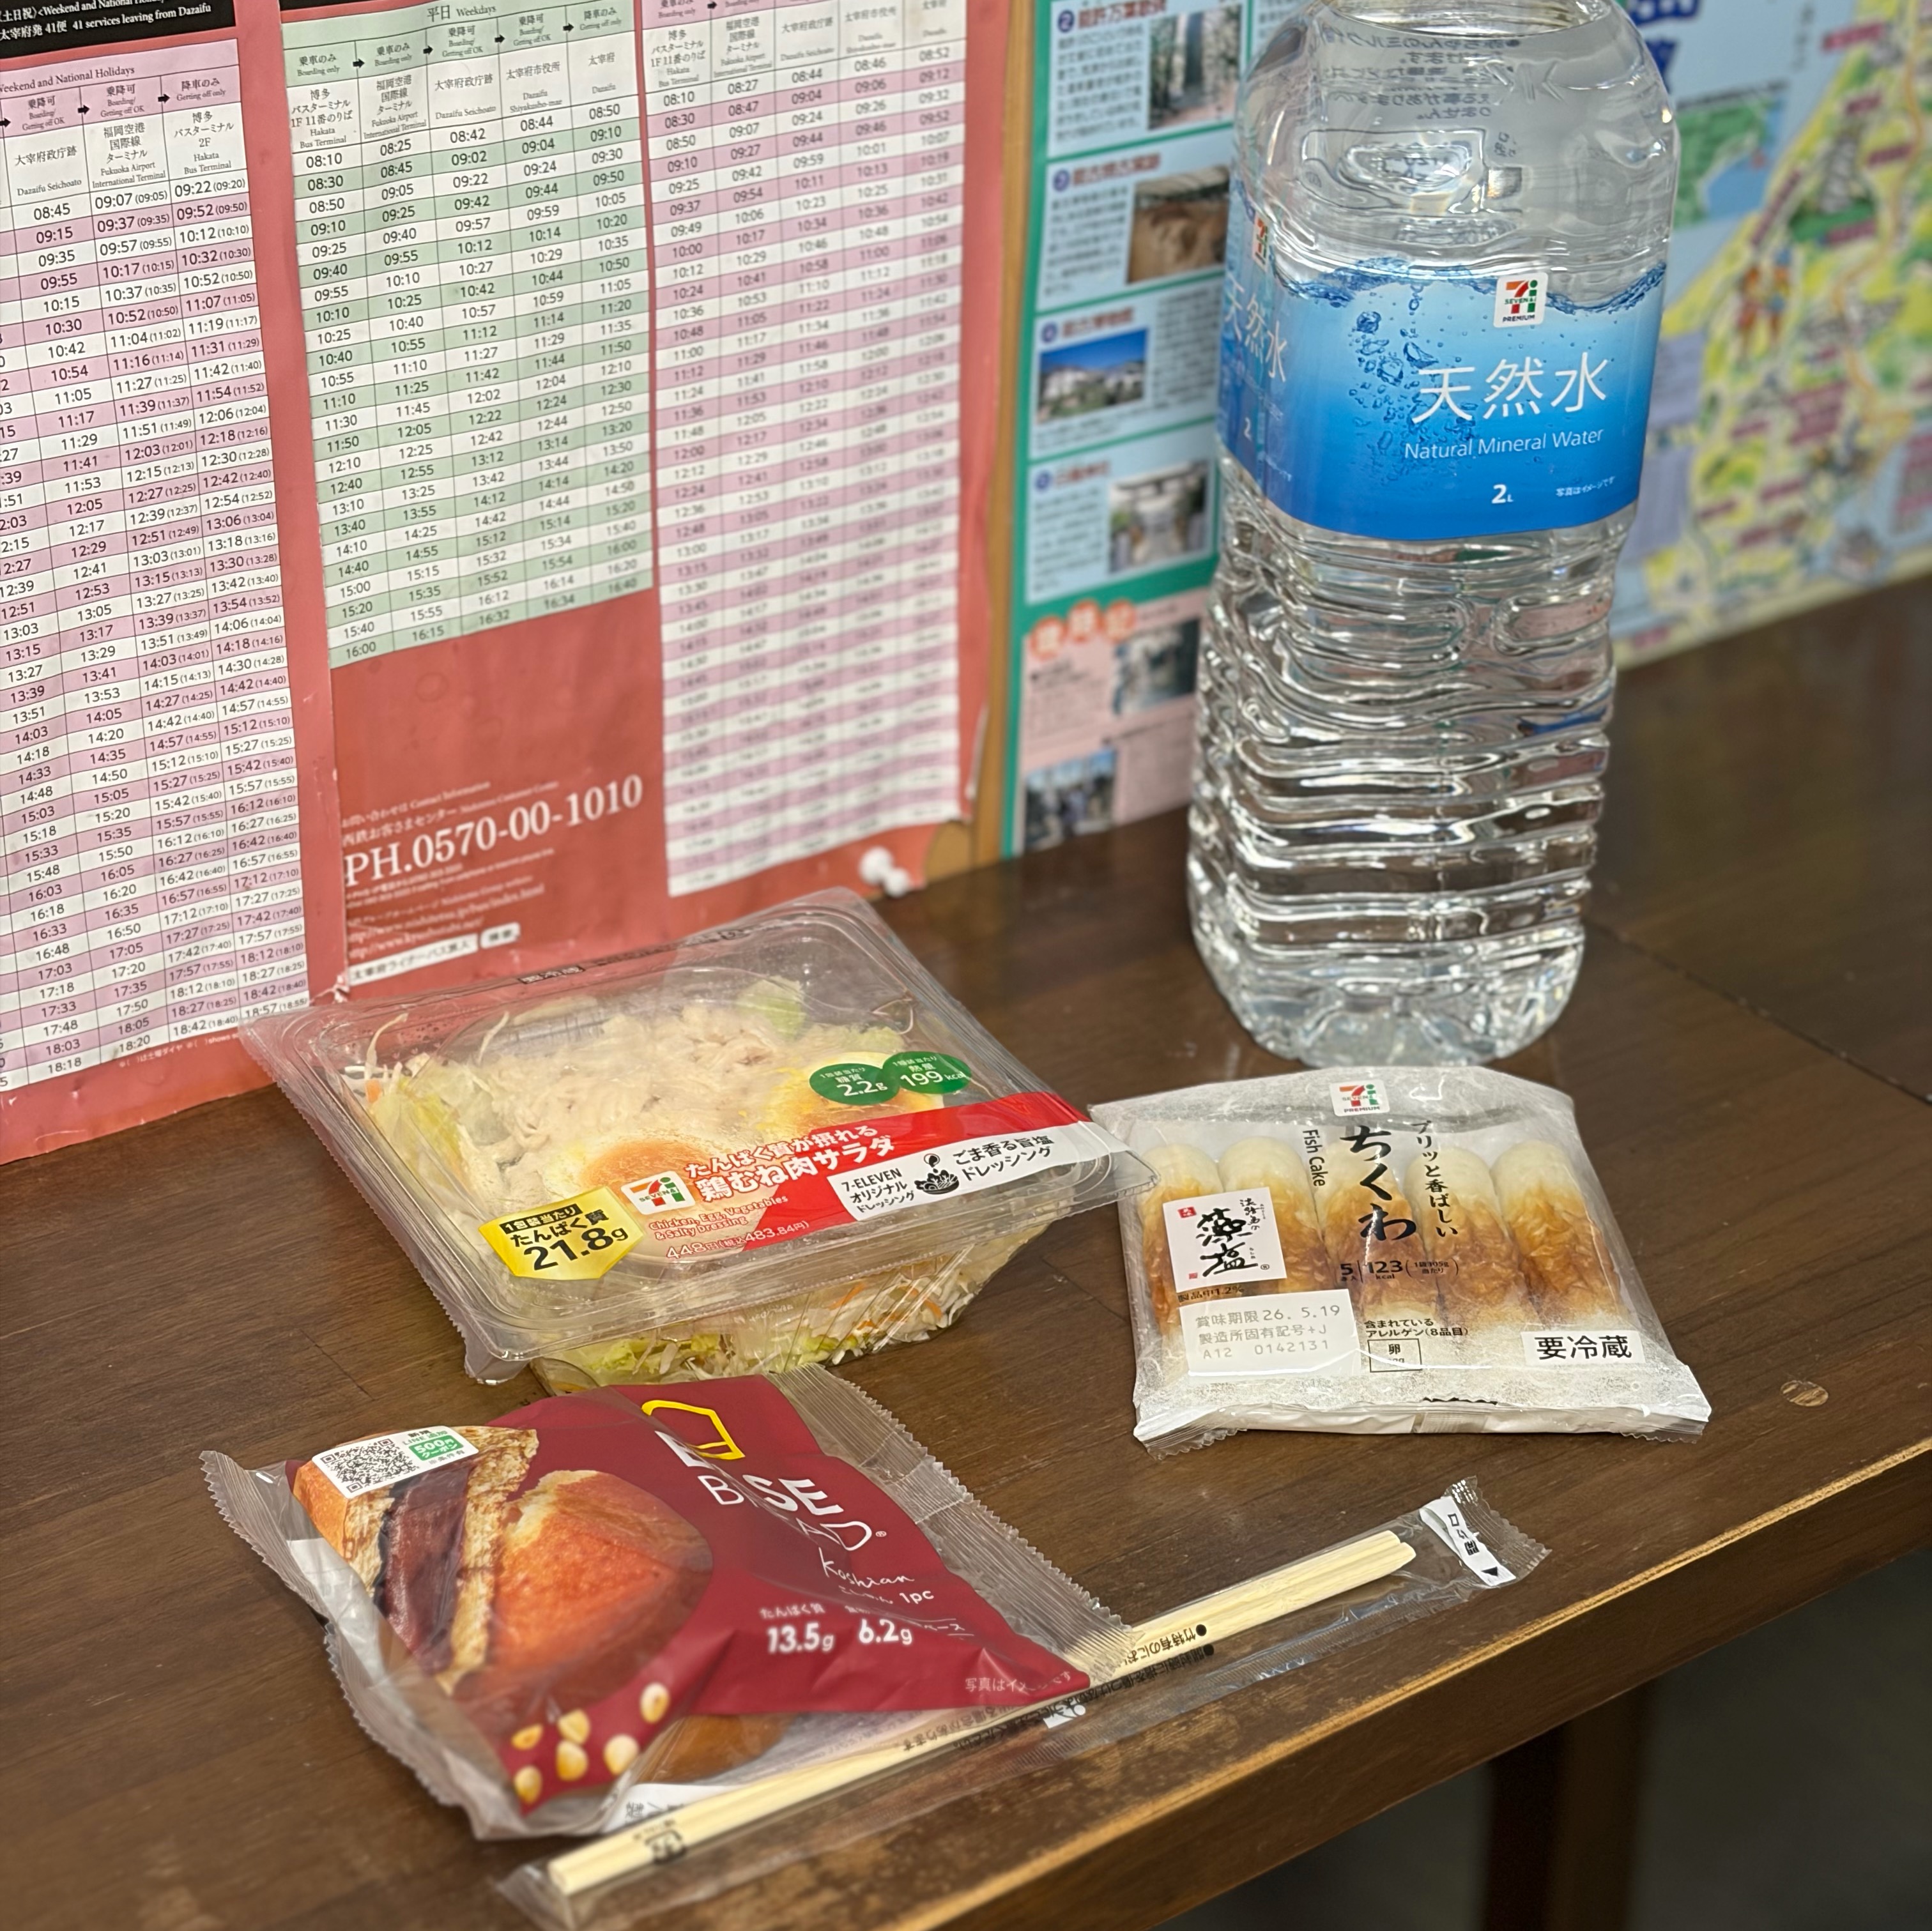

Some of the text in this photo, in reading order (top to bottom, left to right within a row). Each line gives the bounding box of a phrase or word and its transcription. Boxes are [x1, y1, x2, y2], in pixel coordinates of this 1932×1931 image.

[81, 1, 97, 11] and
[427, 5, 496, 22] 平日 Weekdays
[45, 21, 67, 33] 41便
[72, 21, 83, 30] 41
[85, 19, 121, 29] services
[121, 13, 154, 27] leaving
[155, 9, 176, 20] from
[178, 4, 211, 16] Dazaifu
[38, 77, 54, 87] and
[56, 70, 93, 84] National
[95, 66, 135, 79] Holidays
[663, 91, 694, 107] 08:10
[727, 78, 758, 95] 08:27
[192, 112, 213, 124] 博多
[291, 100, 351, 114] バスターミナル
[291, 110, 353, 128] 1F 11番のりば
[103, 122, 145, 139] 福岡空港
[174, 122, 234, 138] バスターミナル
[306, 103, 621, 168] 08:10 08:25 08:42 08:44 08:50
[315, 136, 346, 146] Terminal
[109, 135, 142, 151] 国際線
[199, 138, 211, 148] 2F
[107, 149, 148, 164] ターミナル
[184, 161, 231, 175] Bus Terminal
[194, 152, 219, 162] Hakata
[667, 156, 698, 173] 09:10
[92, 170, 166, 189] International Terminal
[101, 162, 156, 176] Fukuoka Airport
[17, 178, 82, 197] Dazaifu Seichoato
[34, 178, 246, 221] 08:45 09:07 (09:05) 09:22 (09:20)
[310, 171, 625, 237] 09:10 09:25 09:42 09:44 09:50
[36, 204, 215, 244] 09:15 09:37 09:52
[1503, 314, 1535, 323] PREMIUM
[48, 316, 257, 358] 10:42 11:04 11:19 (11:17)
[321, 332, 565, 389] 10:55 11:10 11:27 11:29
[1413, 351, 1609, 423] 天然水
[61, 409, 234, 450] 11:29 11:51 12:06
[1404, 428, 1604, 461] Natural Mineral Water
[330, 444, 433, 495] 12:40 12:25
[73, 536, 243, 580] 12:41 13:03 13:18
[346, 626, 445, 659] 16:00 16:15
[17, 740, 259, 772] 14:18 14:35 15:12 15:27
[344, 775, 643, 887] PH.0570-00-1010
[40, 929, 272, 1000] 17:18 17:20 17:42 17:57
[47, 1057, 82, 1074] 18:18
[118, 1035, 151, 1052] 18:20
[172, 1020, 208, 1036] 18:42
[208, 1015, 238, 1030] (18:40)
[837, 1081, 887, 1097] 2.2g
[900, 1071, 967, 1087] 199 kcal
[686, 1124, 877, 1180] たんぱく質が摂れる
[953, 1134, 1054, 1166] ごま香る旨塩
[1303, 1129, 1326, 1187] Fish Cake
[695, 1136, 896, 1203] 鶏むね肉サラダ
[962, 1147, 1051, 1182] ドレッシング
[841, 1168, 903, 1192] 7-ELEVEN
[849, 1181, 908, 1203] オリジナル
[1340, 1126, 1416, 1242] ちくわ
[649, 1196, 788, 1231] Chicken, Egg, Vegetables
[856, 1191, 915, 1213] ドレッシング
[505, 1206, 577, 1232] 1包装当たり
[510, 1209, 609, 1247] たんぱく質
[655, 1216, 749, 1240] & Salty Dressing
[524, 1228, 629, 1271] 21.8g
[1340, 1263, 1354, 1276] 5
[1367, 1260, 1404, 1274] 123
[1196, 1310, 1259, 1328] 賞味期限
[1364, 1318, 1434, 1329] 含まれている
[1366, 1327, 1468, 1338] アレルゲン(8品目)
[1202, 1347, 1233, 1361] A12
[1388, 1343, 1401, 1355] 卵
[1535, 1334, 1633, 1360] 要冷蔵
[422, 1444, 457, 1458] クーポン
[818, 1546, 915, 1588] Koshian
[899, 1590, 935, 1604] 1pc
[760, 1602, 827, 1619] たんぱく質
[767, 1622, 835, 1653] 13.5g
[858, 1619, 914, 1645] 6.2g
